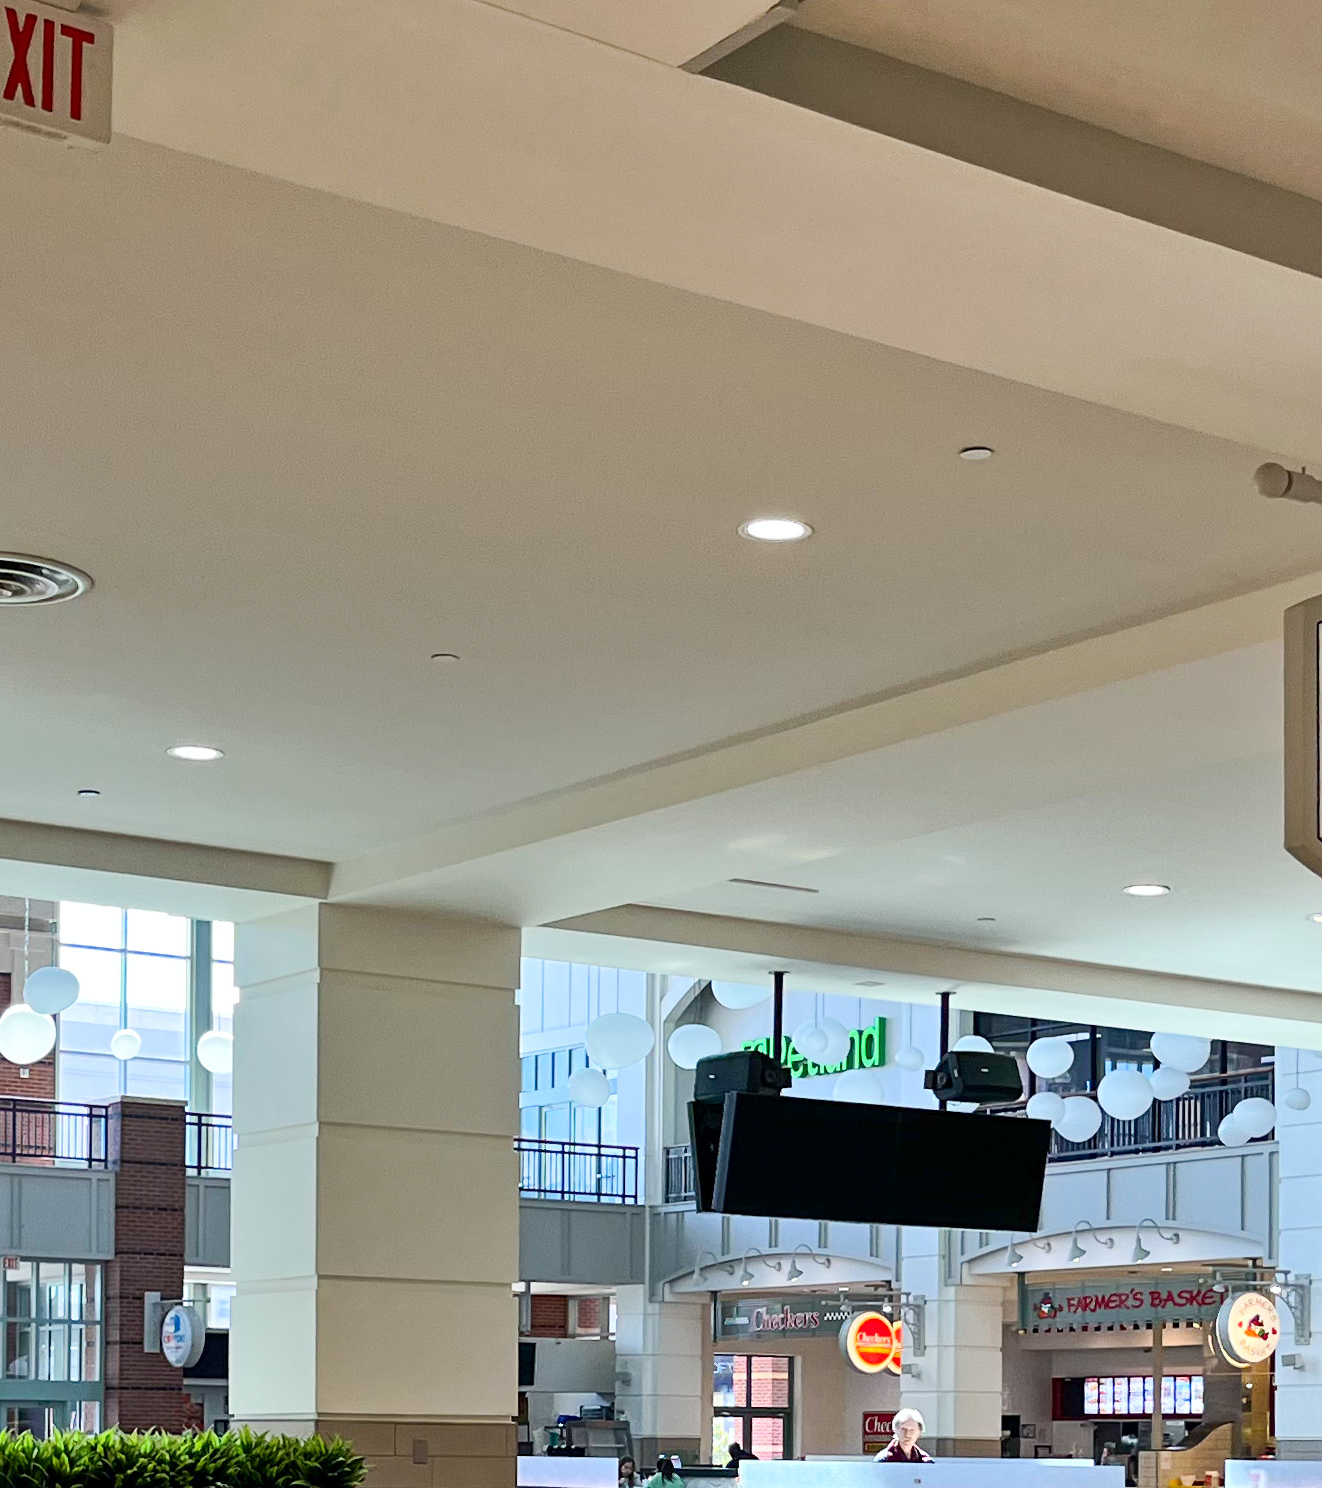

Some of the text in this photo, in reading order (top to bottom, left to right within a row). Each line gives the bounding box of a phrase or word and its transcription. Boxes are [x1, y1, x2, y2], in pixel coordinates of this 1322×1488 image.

[1066, 1287, 1227, 1314] FARMER'S BASKET
[752, 1305, 820, 1332] Checkers
